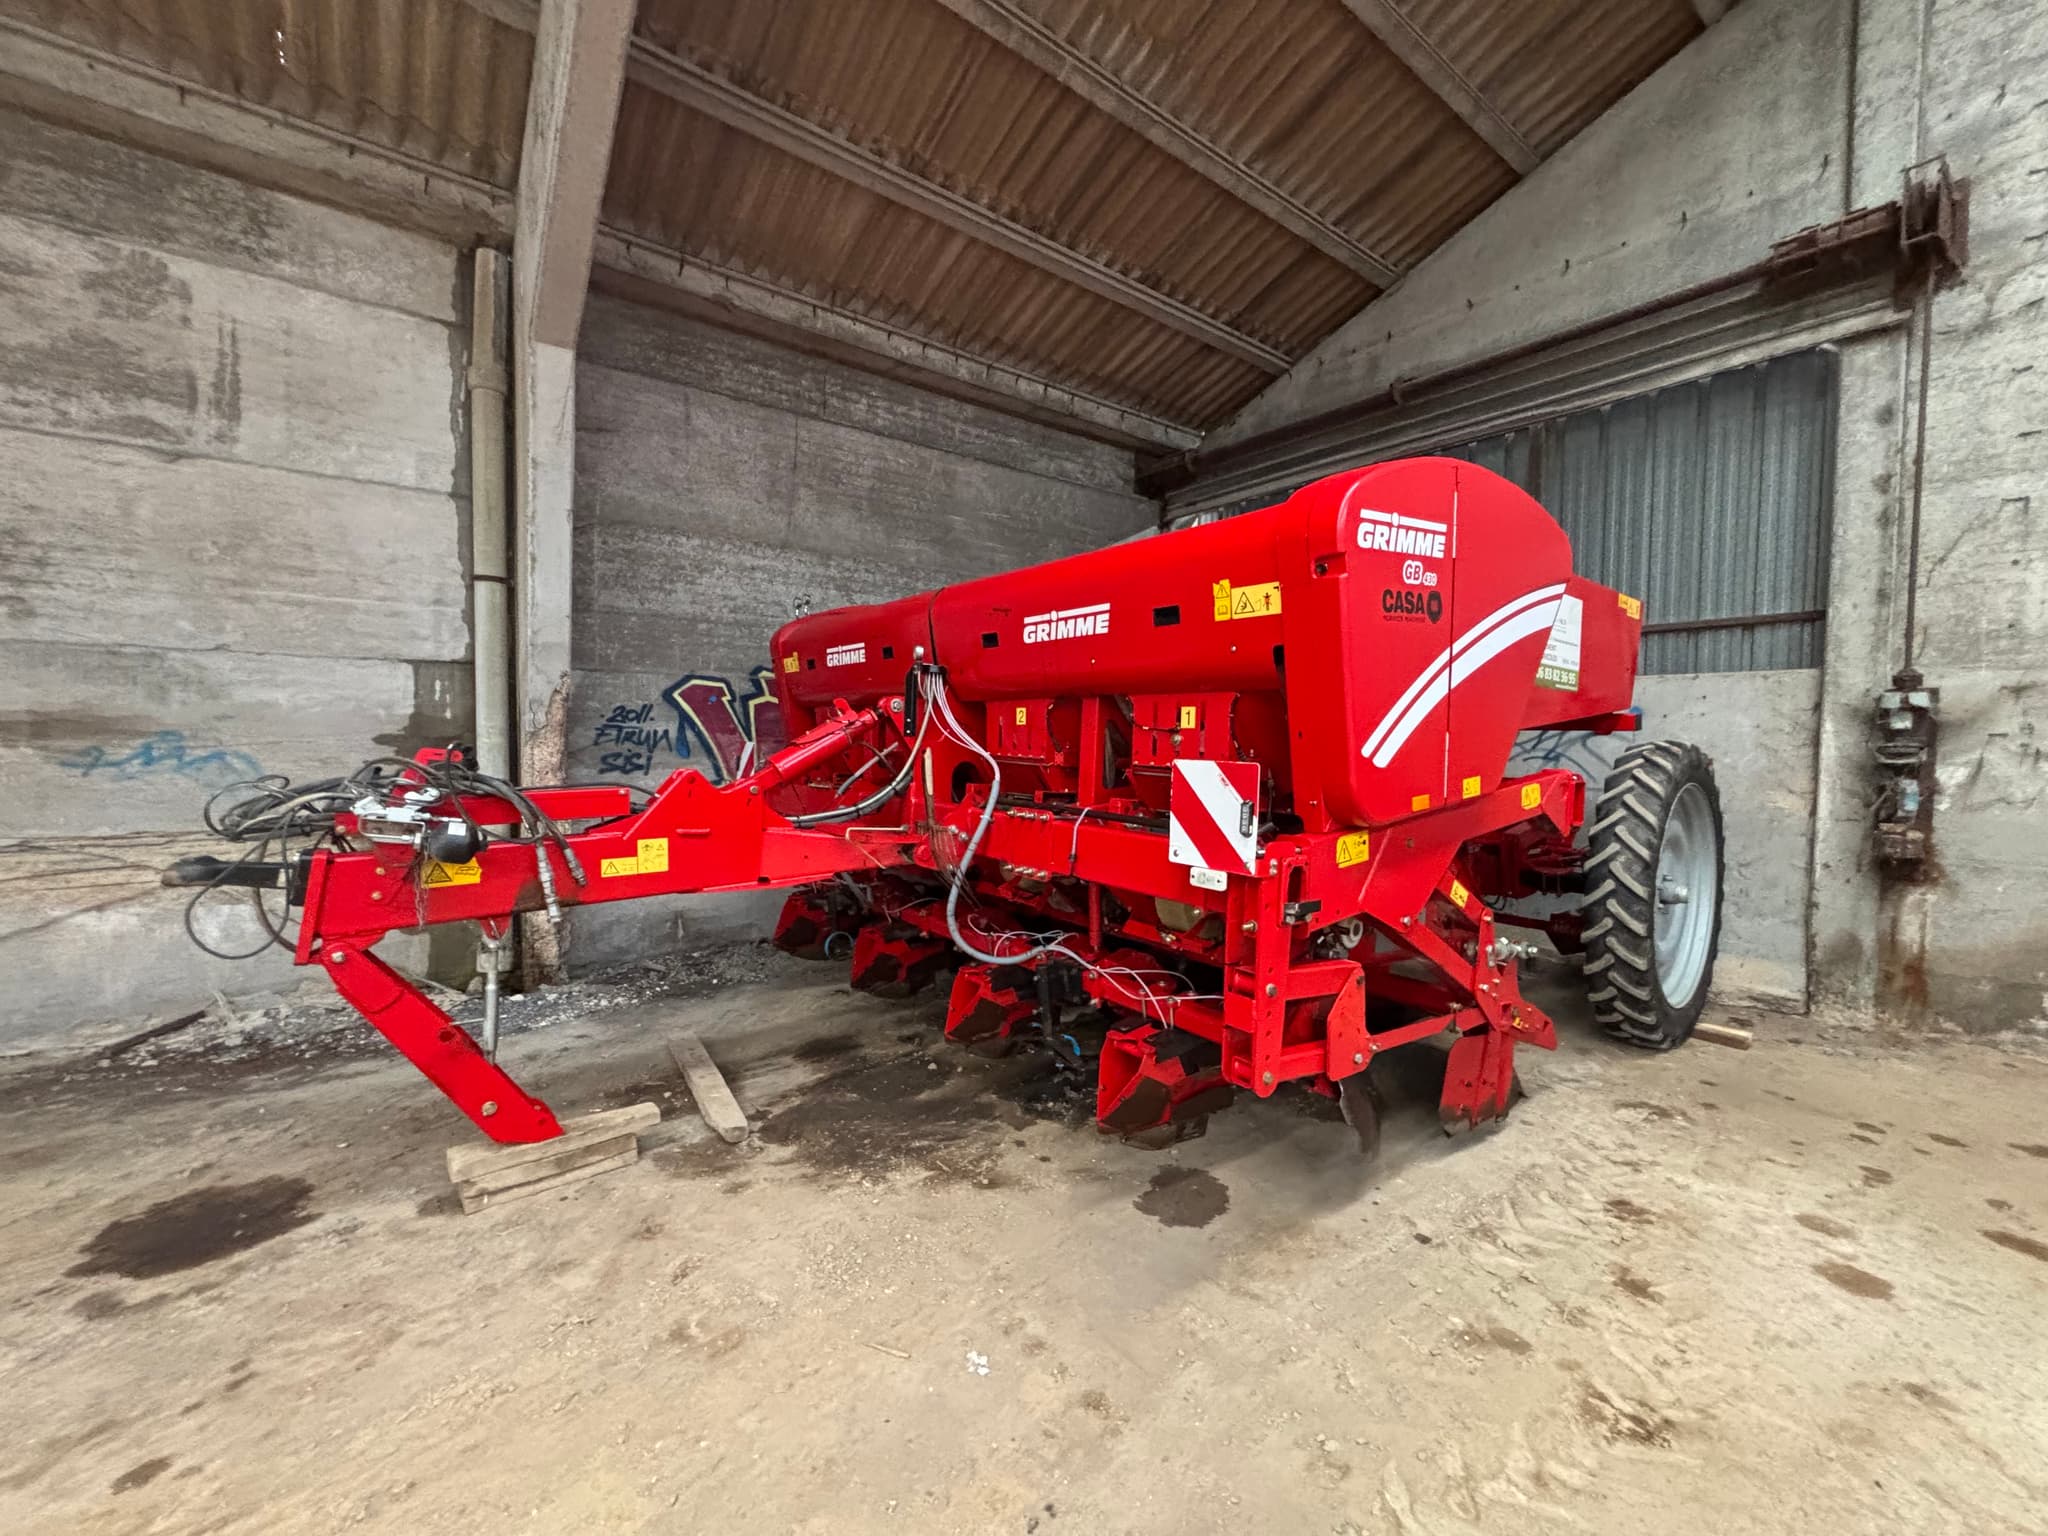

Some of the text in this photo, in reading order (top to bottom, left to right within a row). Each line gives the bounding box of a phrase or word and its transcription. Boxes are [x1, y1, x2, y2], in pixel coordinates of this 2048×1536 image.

[1357, 511, 1447, 558] GRIMME
[1404, 562, 1422, 582] GB
[1023, 608, 1110, 643] GRIMME
[826, 646, 866, 667] GRIMME
[1018, 710, 1025, 723] 2
